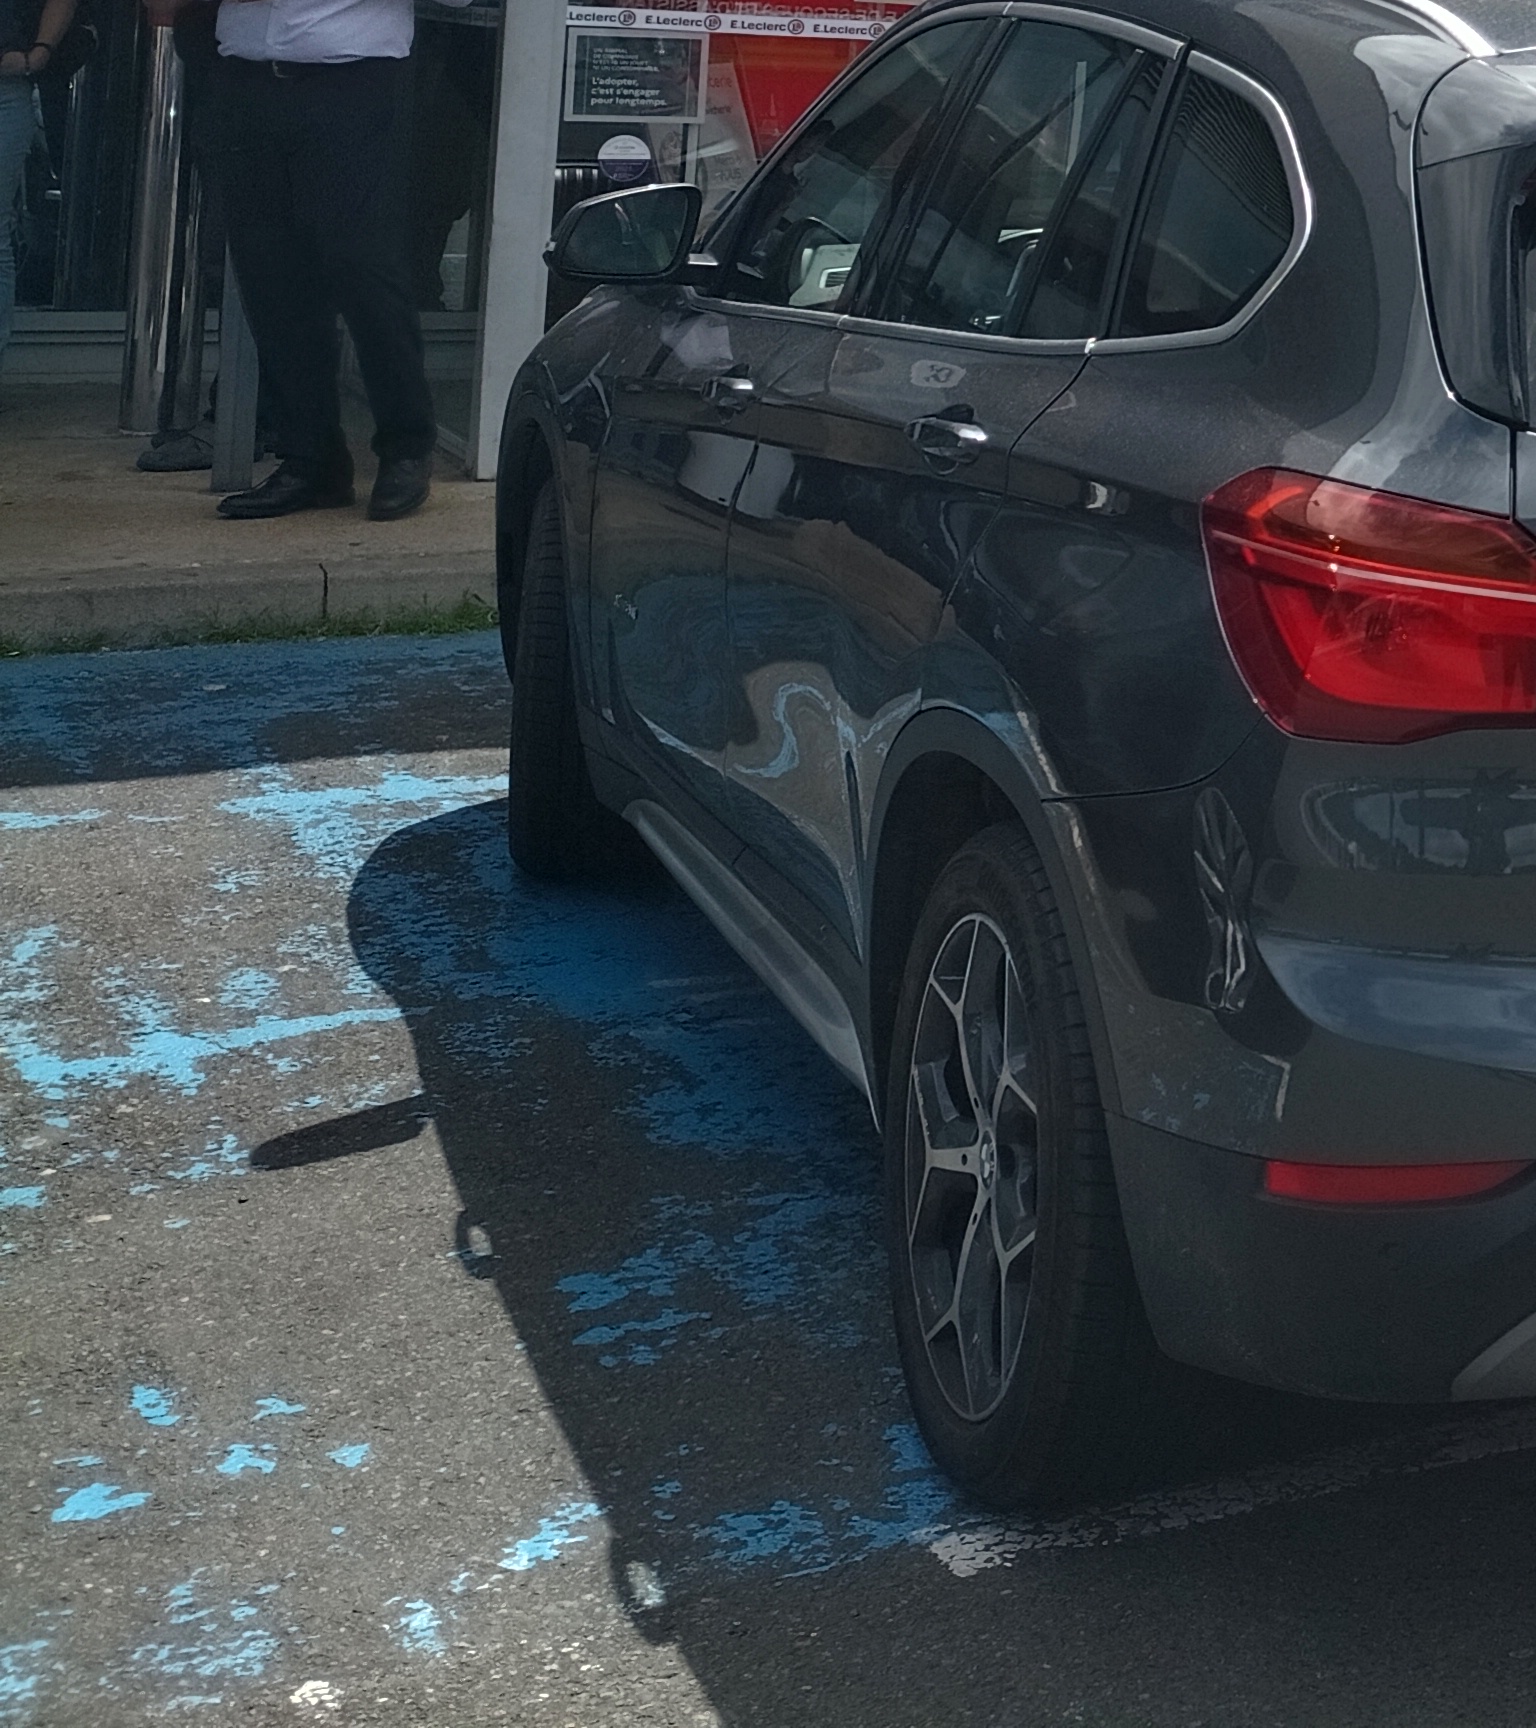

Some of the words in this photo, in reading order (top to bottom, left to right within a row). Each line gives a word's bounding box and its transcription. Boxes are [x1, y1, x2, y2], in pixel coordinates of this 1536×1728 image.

[566, 11, 617, 23] .Leclerc
[645, 15, 703, 28] E.Leclerc
[730, 20, 786, 33] E.Leclerc
[813, 24, 868, 36] E.Leclerc
[592, 77, 640, 87] L'adopter,
[591, 87, 614, 95] c'est
[616, 88, 660, 98] s'engager
[591, 97, 613, 106] pour
